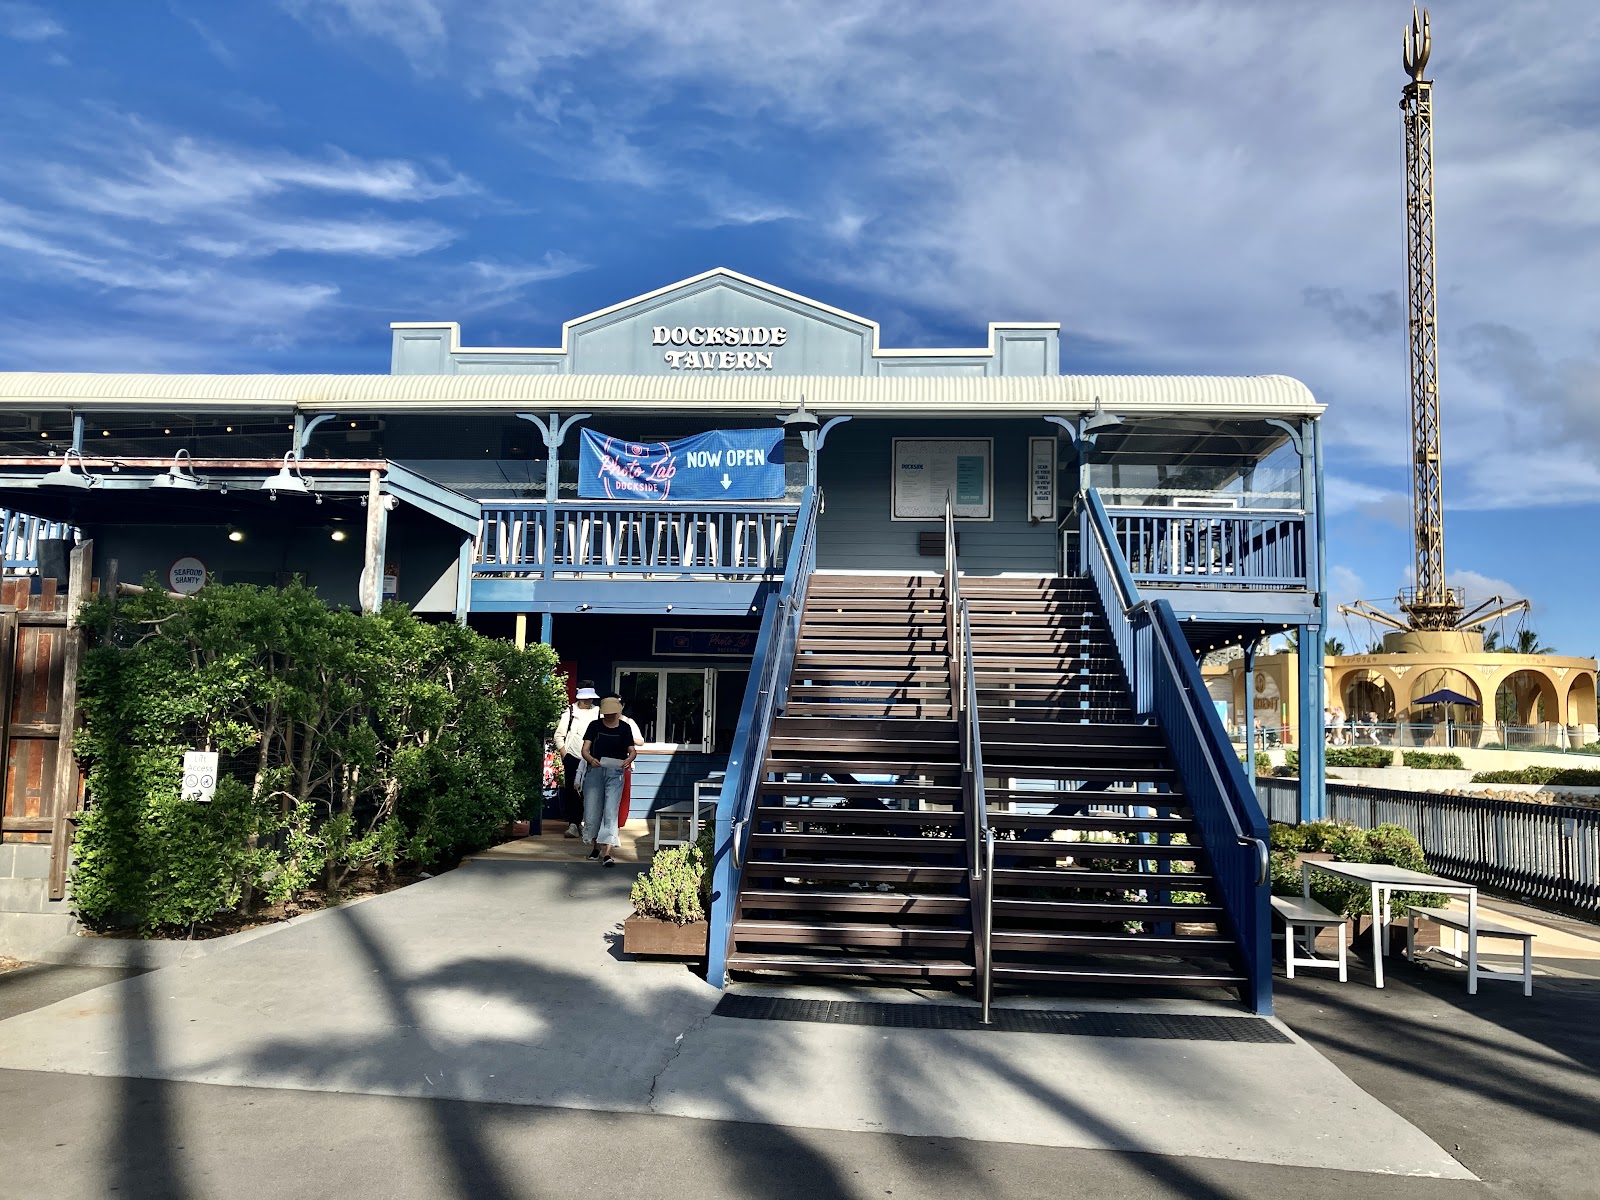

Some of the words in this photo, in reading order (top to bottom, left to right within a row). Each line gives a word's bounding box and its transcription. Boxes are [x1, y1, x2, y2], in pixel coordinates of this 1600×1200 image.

[652, 326, 787, 347] DOCKSIDE
[664, 350, 773, 371] TAVERN
[686, 450, 722, 468] NOW
[726, 449, 765, 467] OPEN
[598, 454, 645, 479] Photo
[645, 456, 677, 481] Lab
[615, 481, 659, 492] DOCKSIDE
[708, 634, 733, 647] Photo
[194, 754, 206, 762] Lift
[187, 764, 213, 772] Access
